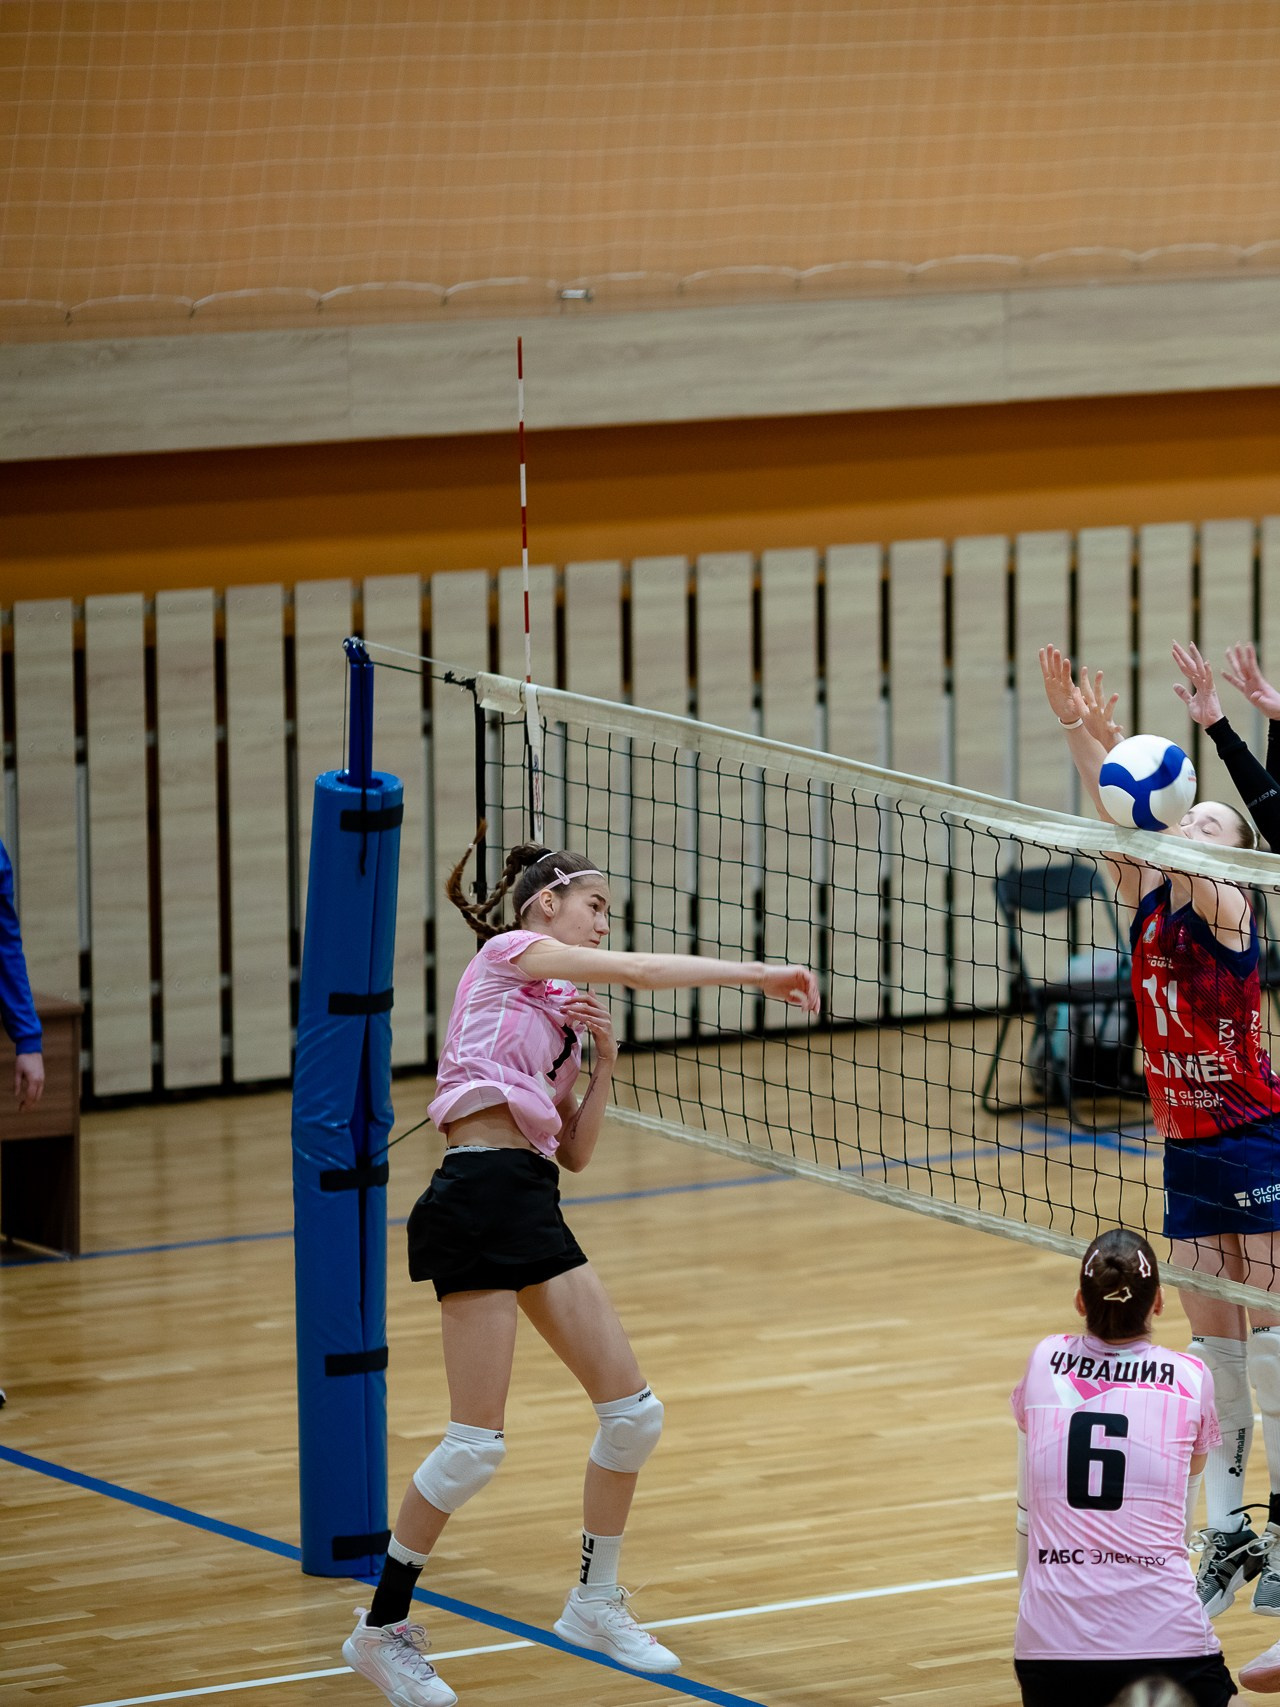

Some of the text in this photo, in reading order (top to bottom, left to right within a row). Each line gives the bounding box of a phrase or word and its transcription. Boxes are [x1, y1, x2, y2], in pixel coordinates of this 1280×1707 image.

[1142, 973, 1193, 1038] 11
[1050, 1351, 1175, 1386] ЧУВАШИЯ
[1066, 1410, 1129, 1512] 6
[1048, 1548, 1166, 1568] АБС Электро
